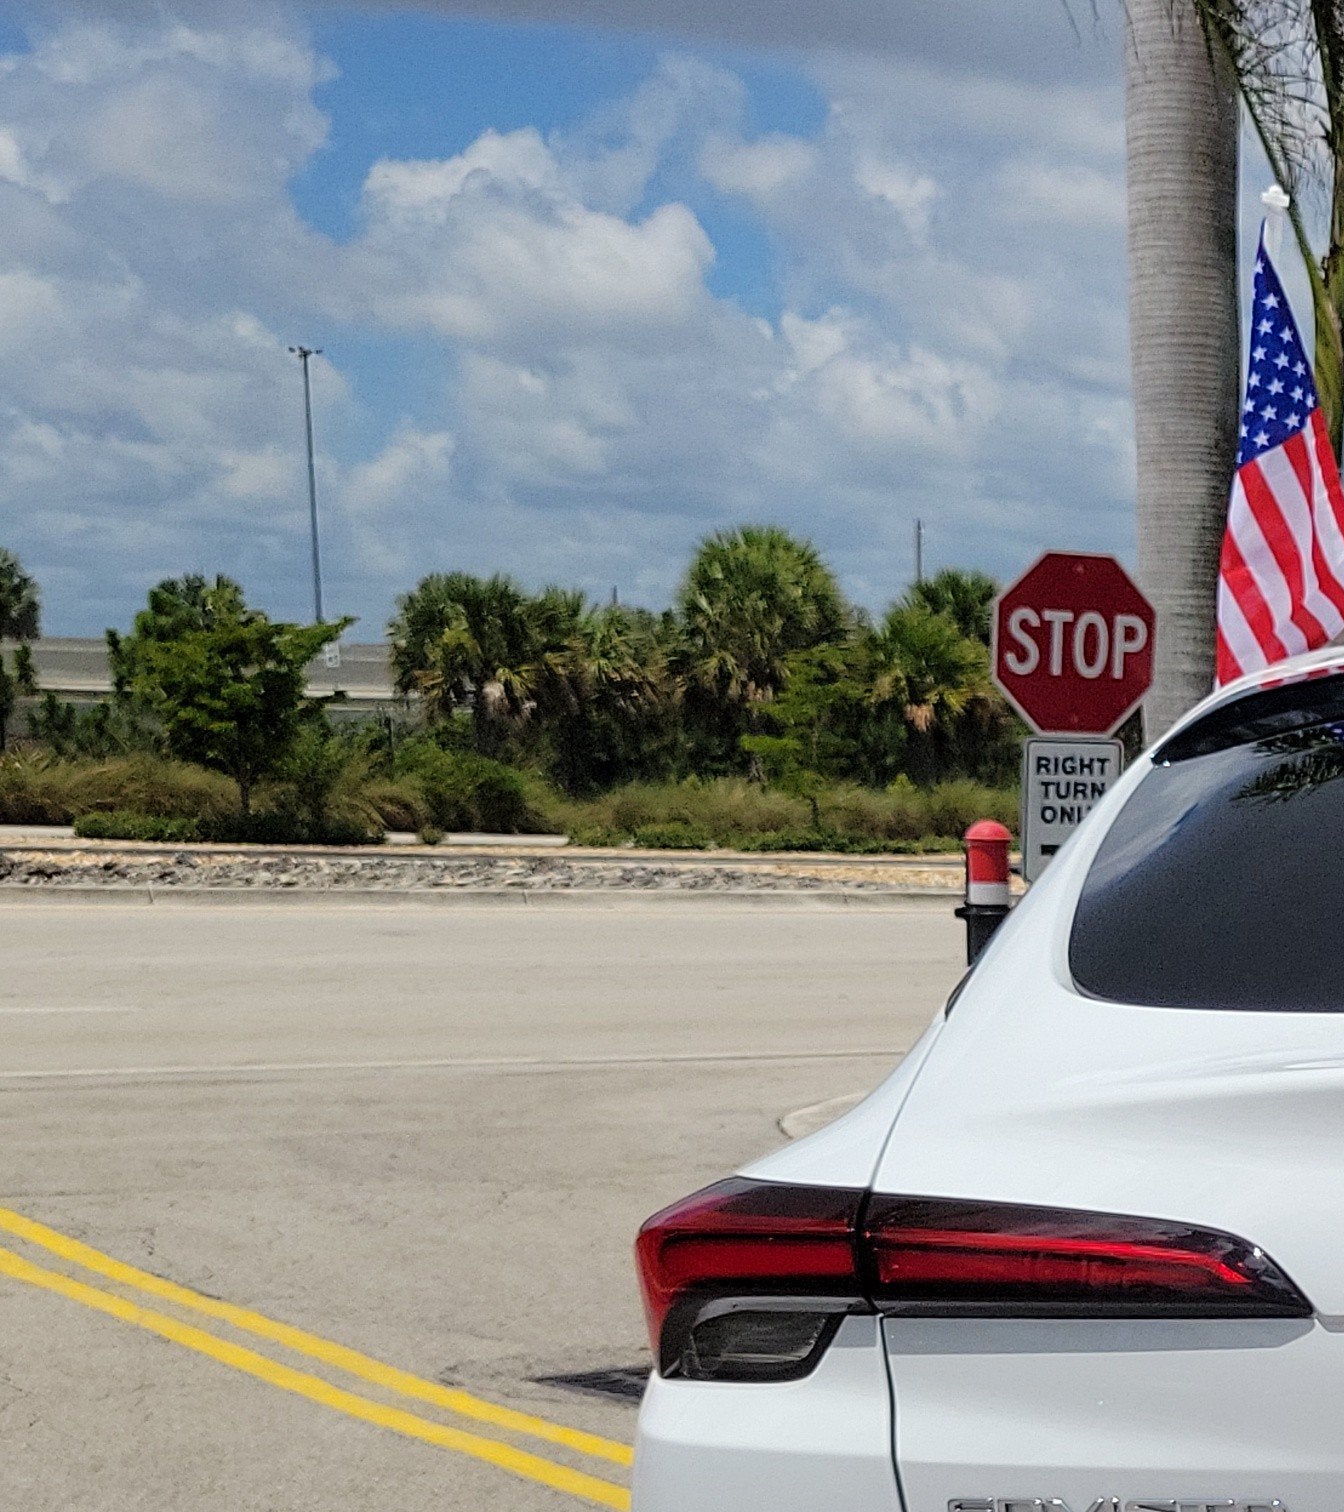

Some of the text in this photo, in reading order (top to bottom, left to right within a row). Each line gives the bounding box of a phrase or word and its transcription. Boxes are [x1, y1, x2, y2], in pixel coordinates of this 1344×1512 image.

[1004, 607, 1149, 679] STOP
[1036, 756, 1111, 776] RIGHT
[1040, 781, 1106, 801] TURN
[1040, 805, 1094, 825] ONL
